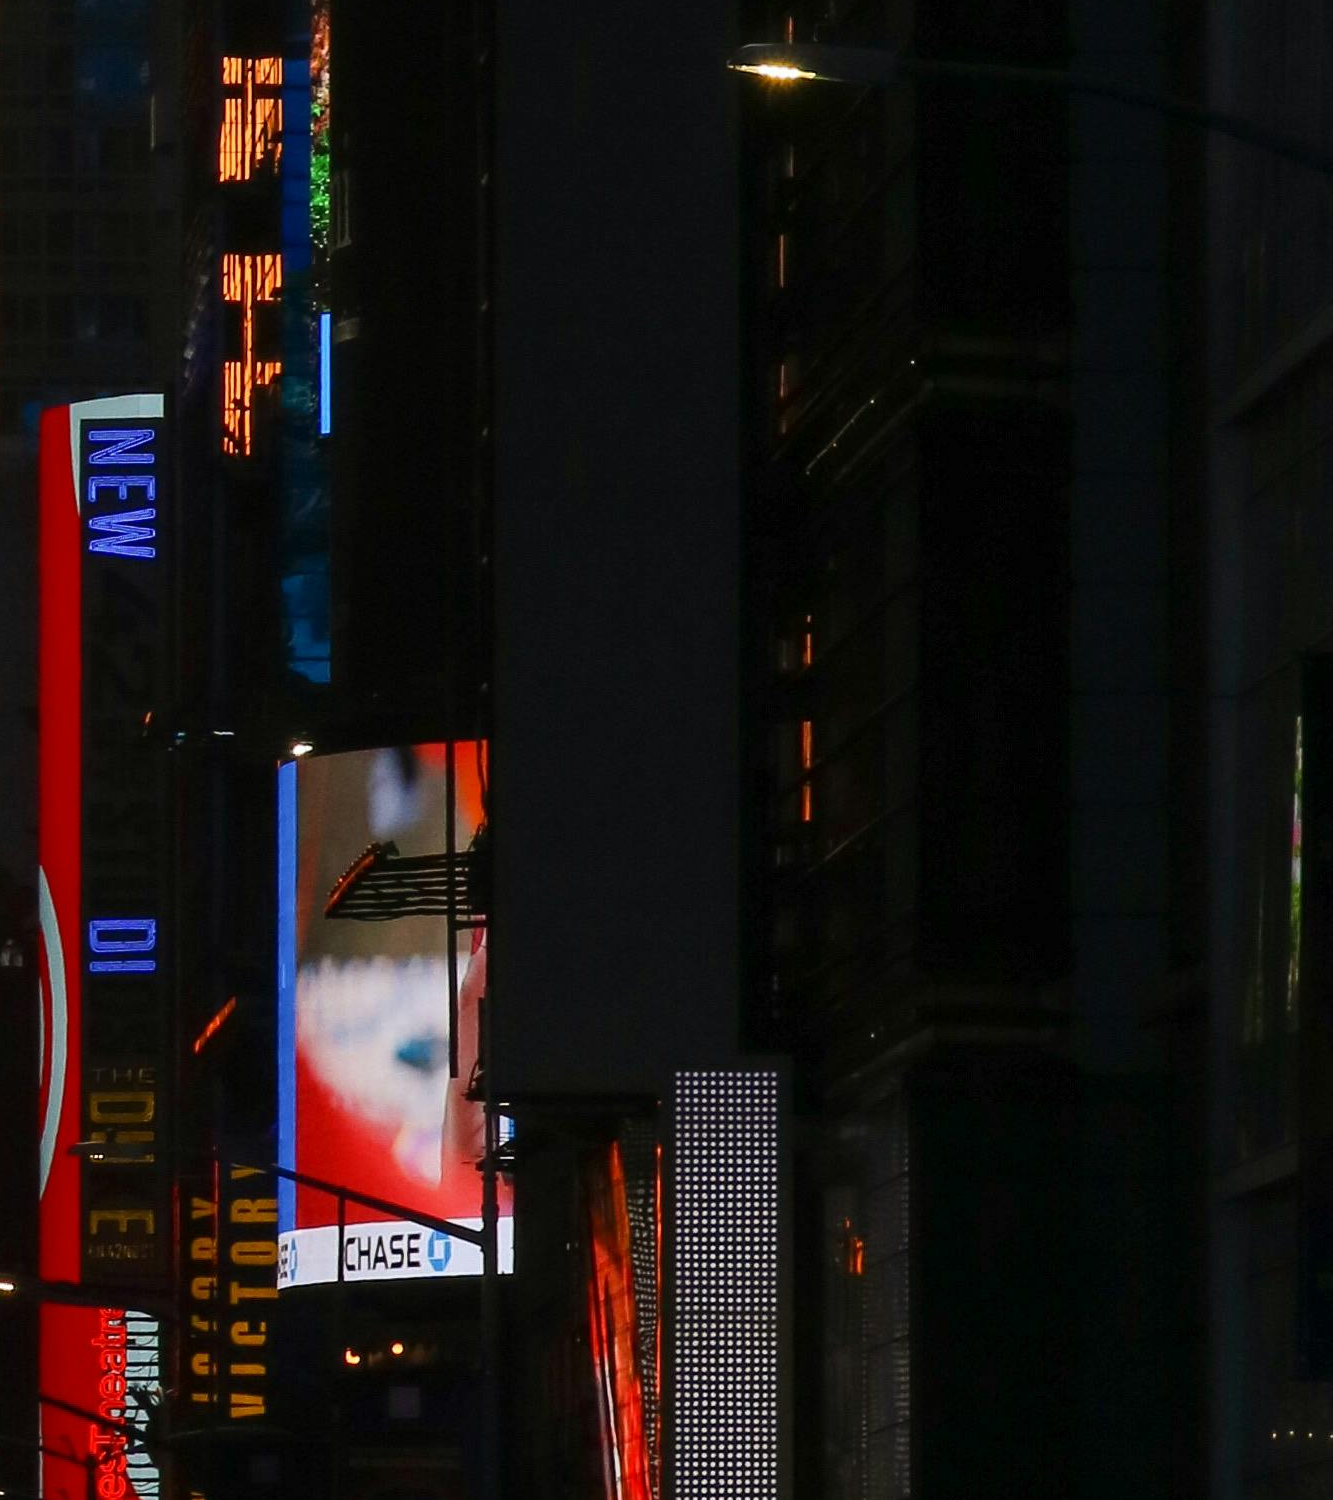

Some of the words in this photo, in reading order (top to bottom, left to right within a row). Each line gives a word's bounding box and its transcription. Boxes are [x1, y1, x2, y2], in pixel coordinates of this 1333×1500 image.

[87, 427, 157, 561] NEW
[229, 1161, 280, 1419] VICTORY
[344, 1233, 422, 1272] CHASE
